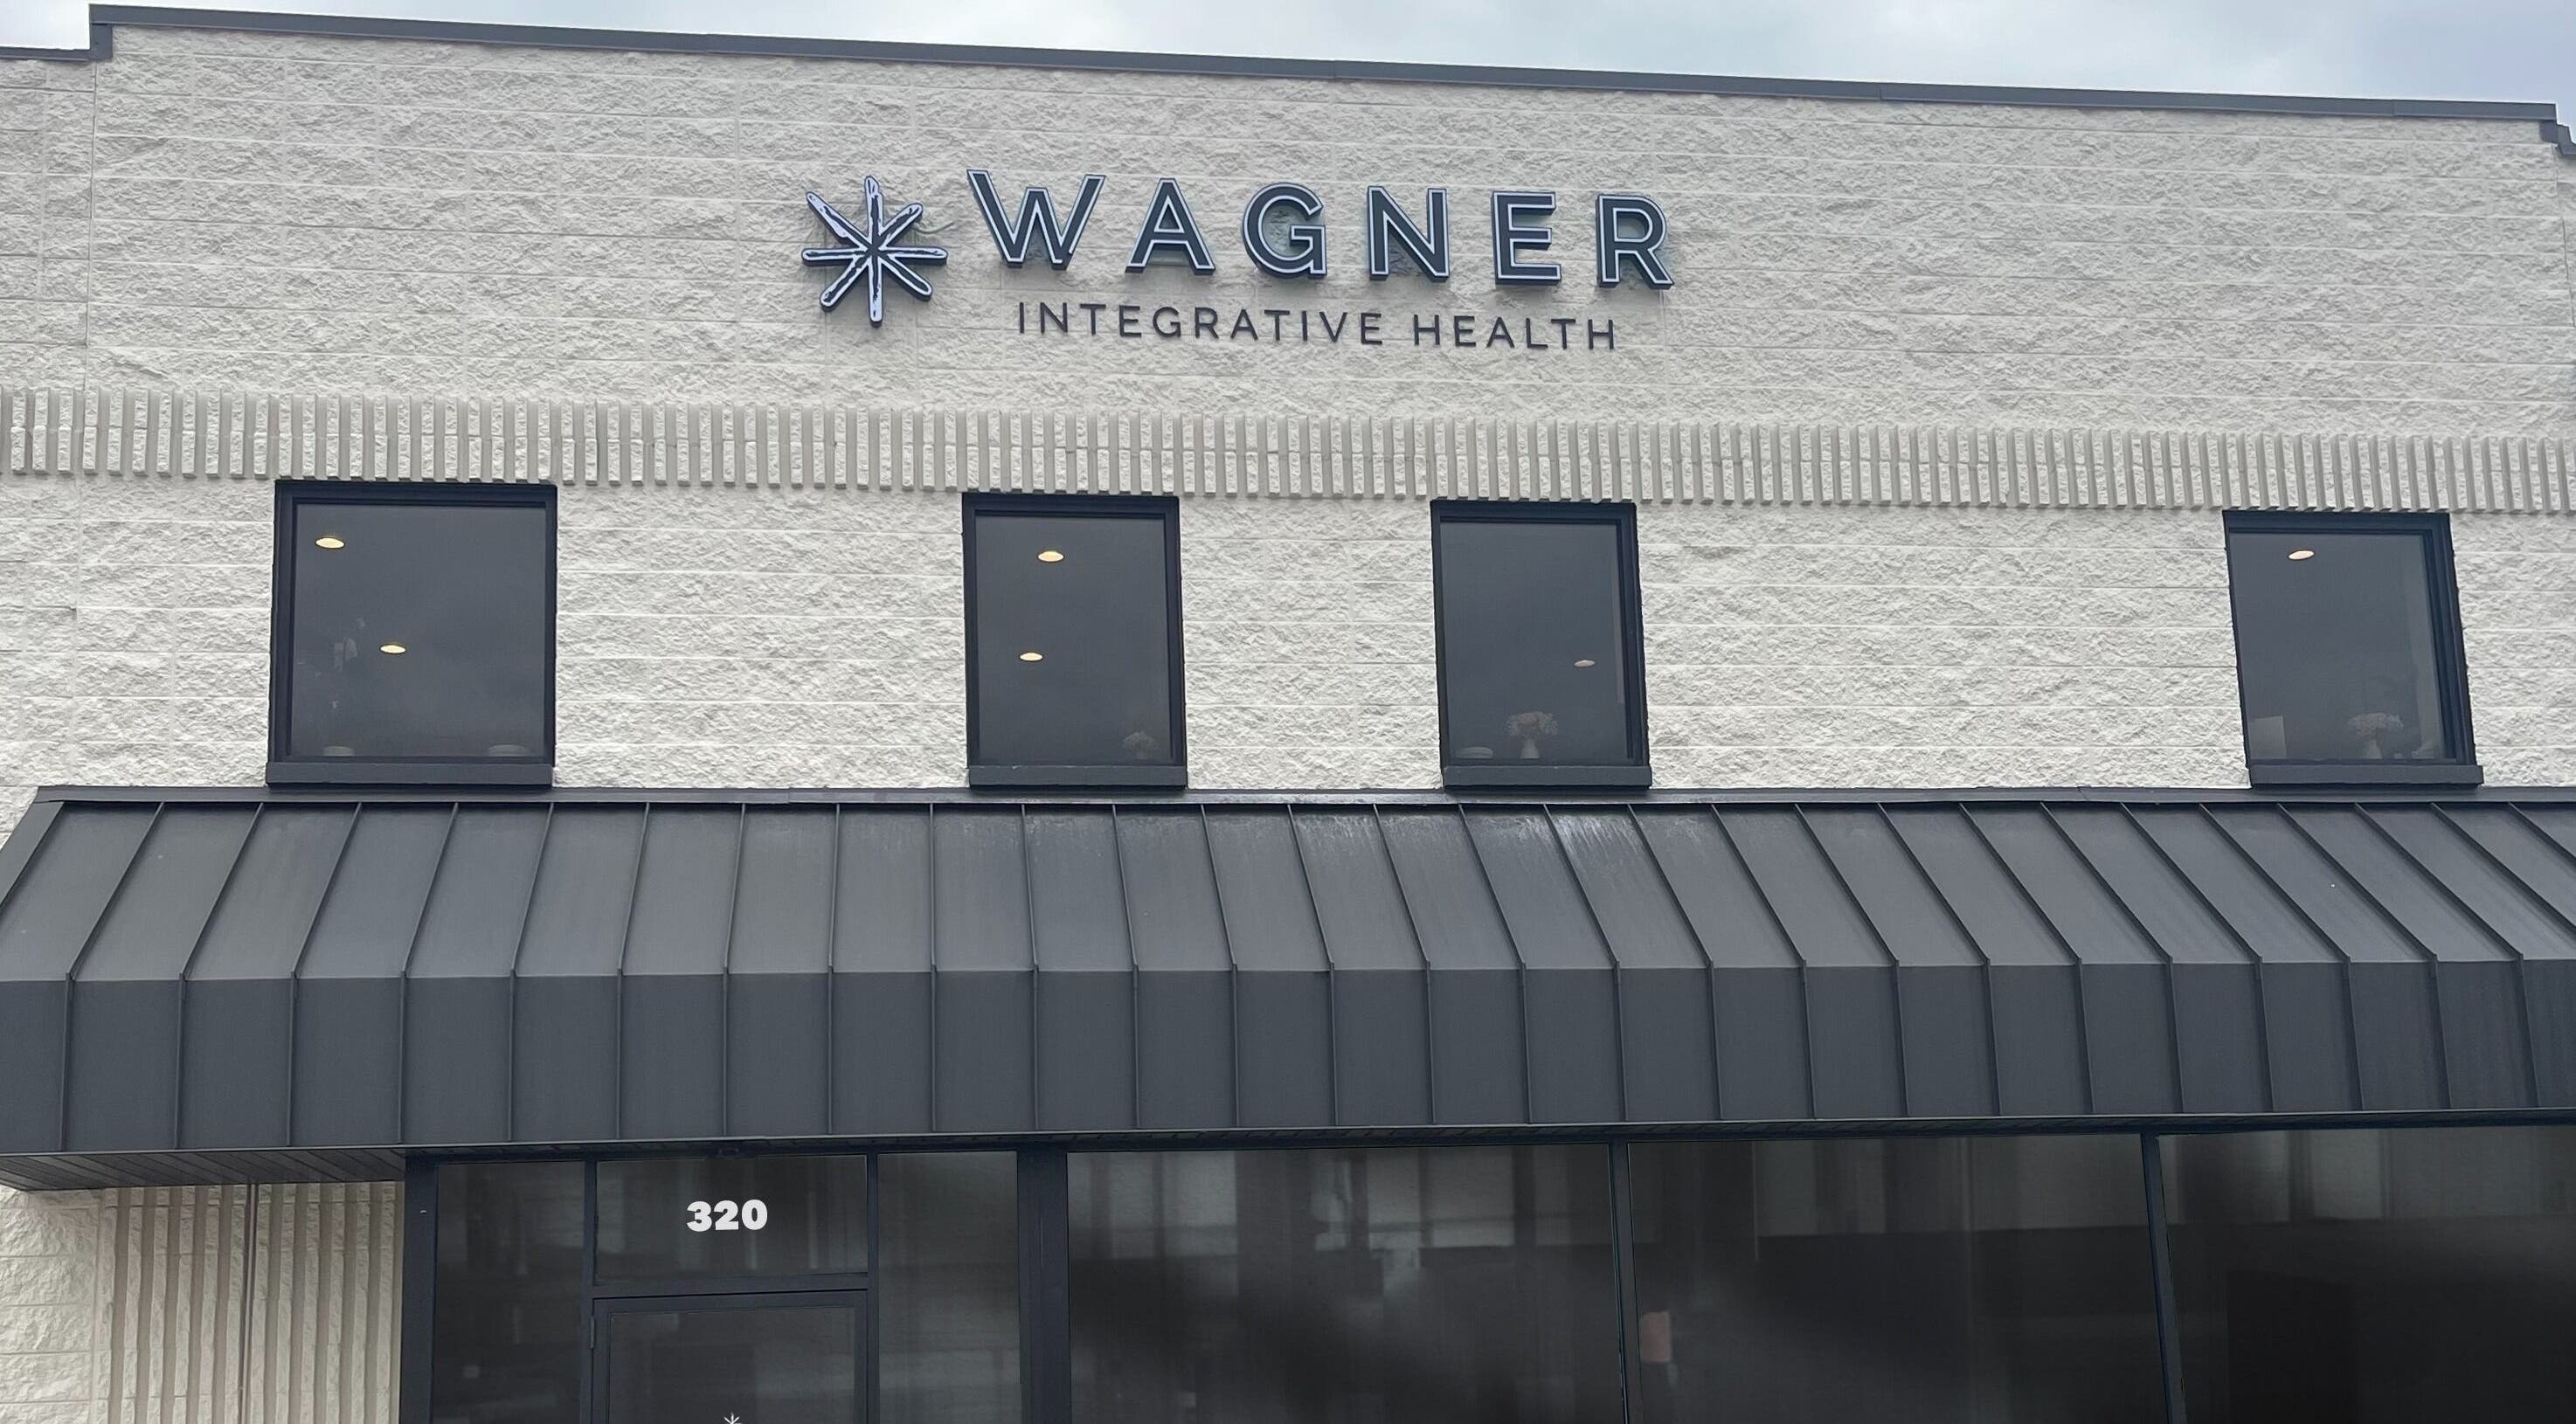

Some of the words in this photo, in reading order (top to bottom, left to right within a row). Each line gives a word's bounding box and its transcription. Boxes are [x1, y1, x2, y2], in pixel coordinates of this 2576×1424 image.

[966, 169, 1674, 289] WAGNER
[1018, 301, 1383, 345] INTEGRATIVE
[1414, 313, 1617, 350] HEALTH
[686, 1199, 768, 1233] 320
